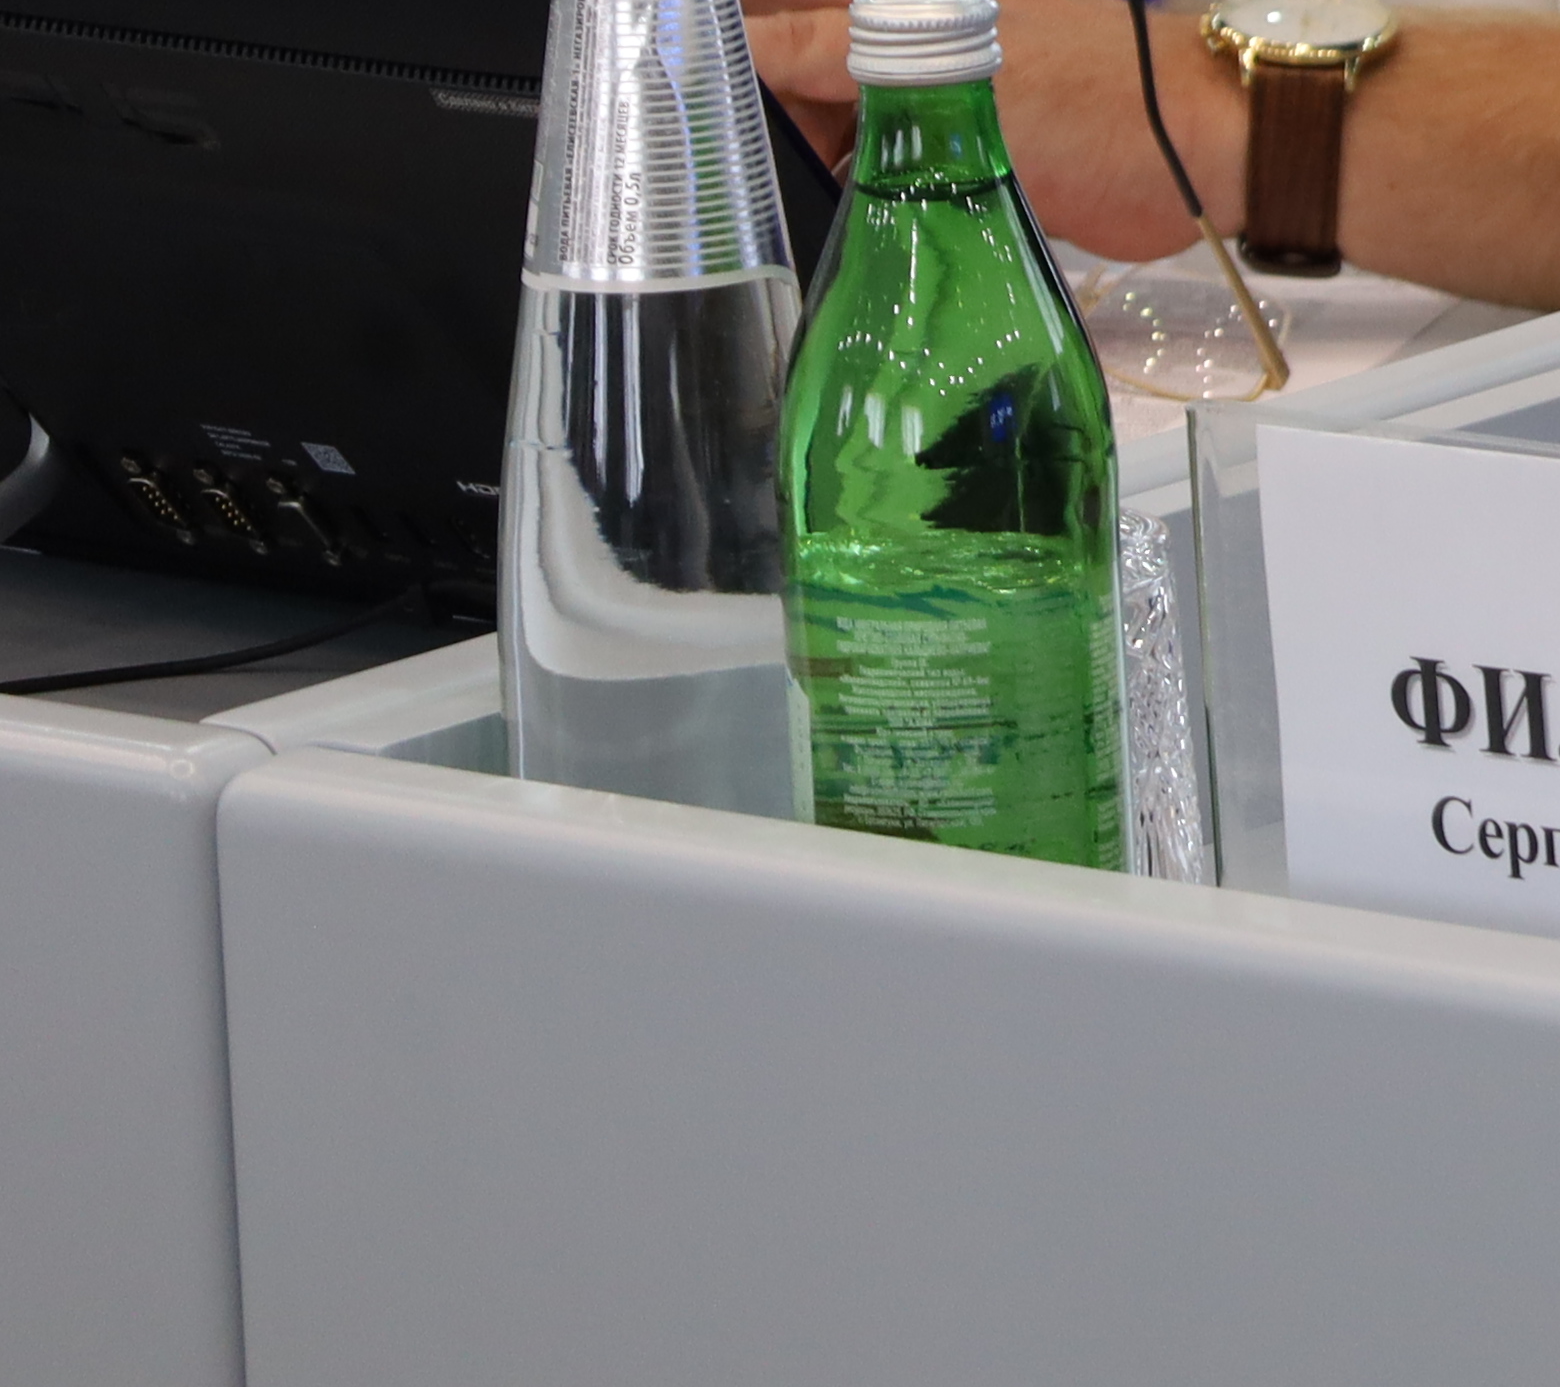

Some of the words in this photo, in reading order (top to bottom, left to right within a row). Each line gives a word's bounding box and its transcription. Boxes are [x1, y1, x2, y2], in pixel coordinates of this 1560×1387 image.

[613, 156, 625, 170] 12
[561, 167, 574, 227] ПИТЬЕВАЯ
[609, 173, 624, 233] ГОДНОСТИ
[623, 171, 642, 206] 0,5л
[558, 230, 571, 262] ВОДА
[606, 235, 618, 265] СРОК
[618, 210, 637, 265] Объем
[456, 479, 501, 496] HD
